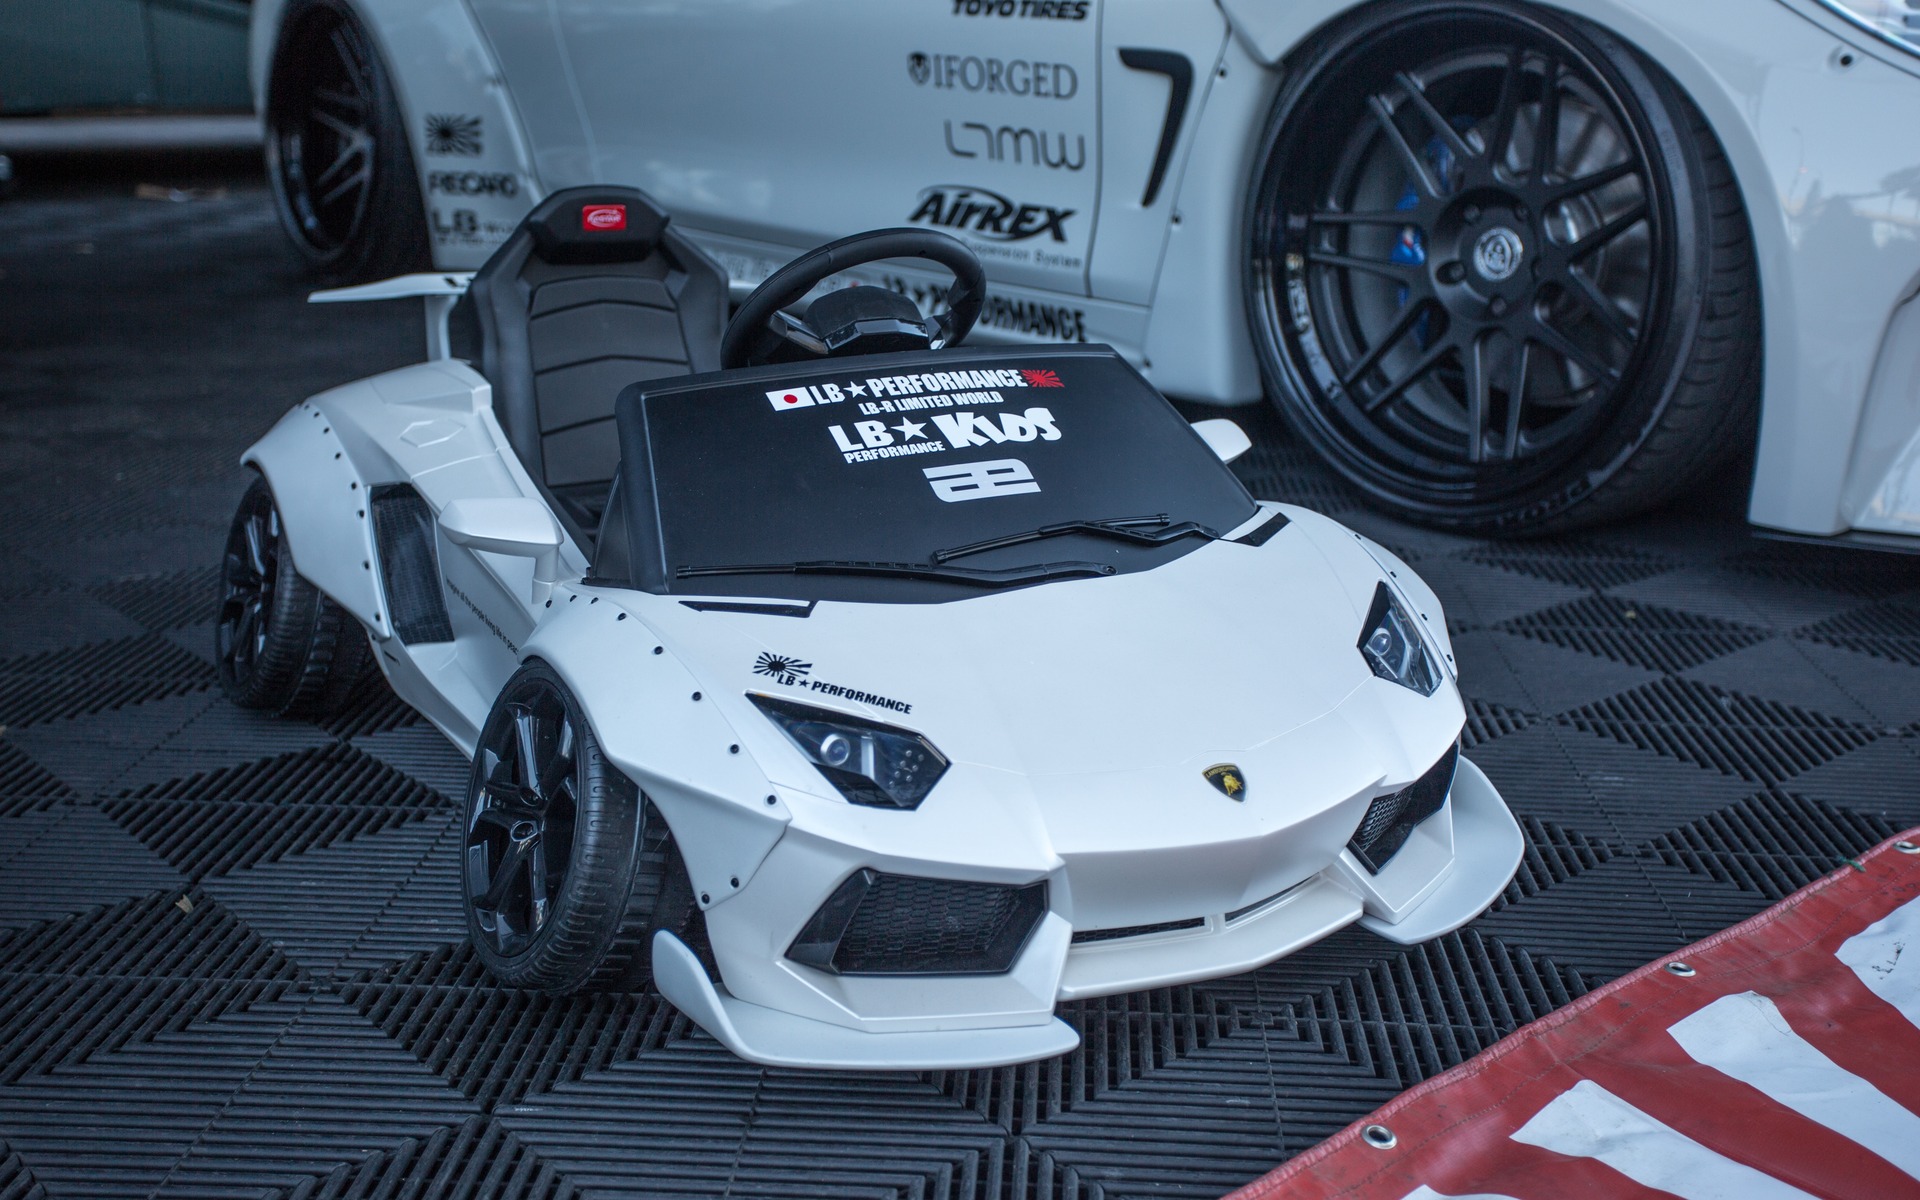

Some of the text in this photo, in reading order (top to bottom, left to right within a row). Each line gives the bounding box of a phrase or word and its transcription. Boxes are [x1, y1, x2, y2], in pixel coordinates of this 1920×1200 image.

[933, 54, 1078, 100] IFORGED
[808, 369, 1028, 405] LB PERFORMANCE
[858, 391, 1004, 415] LB-R LIMITED WORLD
[828, 420, 894, 453] LB
[843, 441, 945, 463] PERFORMANCE
[777, 673, 912, 714] LB PERFORMANCE
